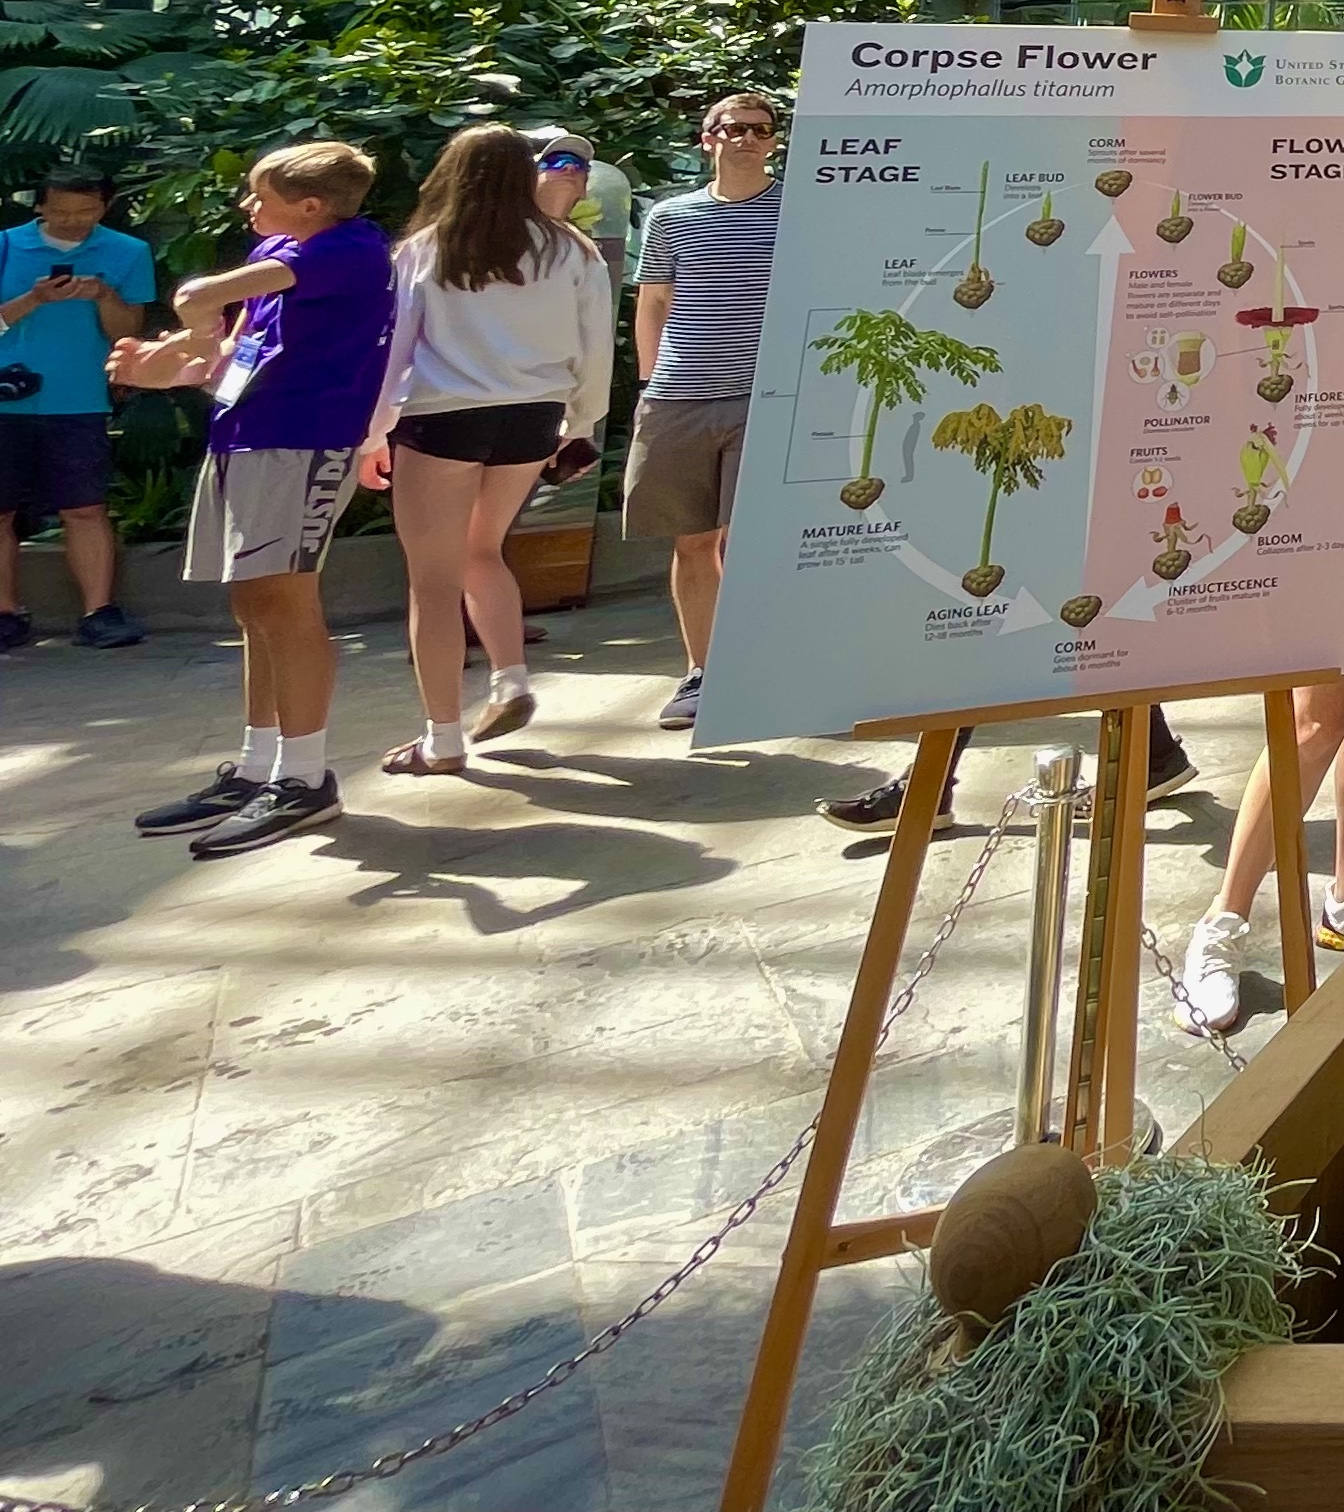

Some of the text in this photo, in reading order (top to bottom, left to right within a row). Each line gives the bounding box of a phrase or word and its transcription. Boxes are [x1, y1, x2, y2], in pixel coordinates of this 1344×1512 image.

[851, 42, 1158, 74] Corpse Flower
[844, 78, 1115, 100] Amorphophallus titanum
[819, 138, 902, 155] LEAF
[1089, 138, 1126, 148] CORM
[815, 165, 920, 183] STAGE
[1006, 173, 1065, 183] LEAF BUD
[1189, 193, 1223, 201] FLOWER
[885, 258, 917, 269] LEAF
[1129, 269, 1178, 279] FLOWERS
[1144, 415, 1211, 427] POLLINATOR
[1130, 447, 1168, 457] FRUITS
[302, 485, 338, 554] JUST
[801, 521, 902, 539] MATURE LEAF
[1257, 533, 1302, 546] BLOOM
[1168, 577, 1279, 597] INFRUCTESCENCE
[926, 603, 1010, 621] AGING LEAF
[1166, 607, 1185, 615] 6-12
[1055, 639, 1096, 654] CORM
